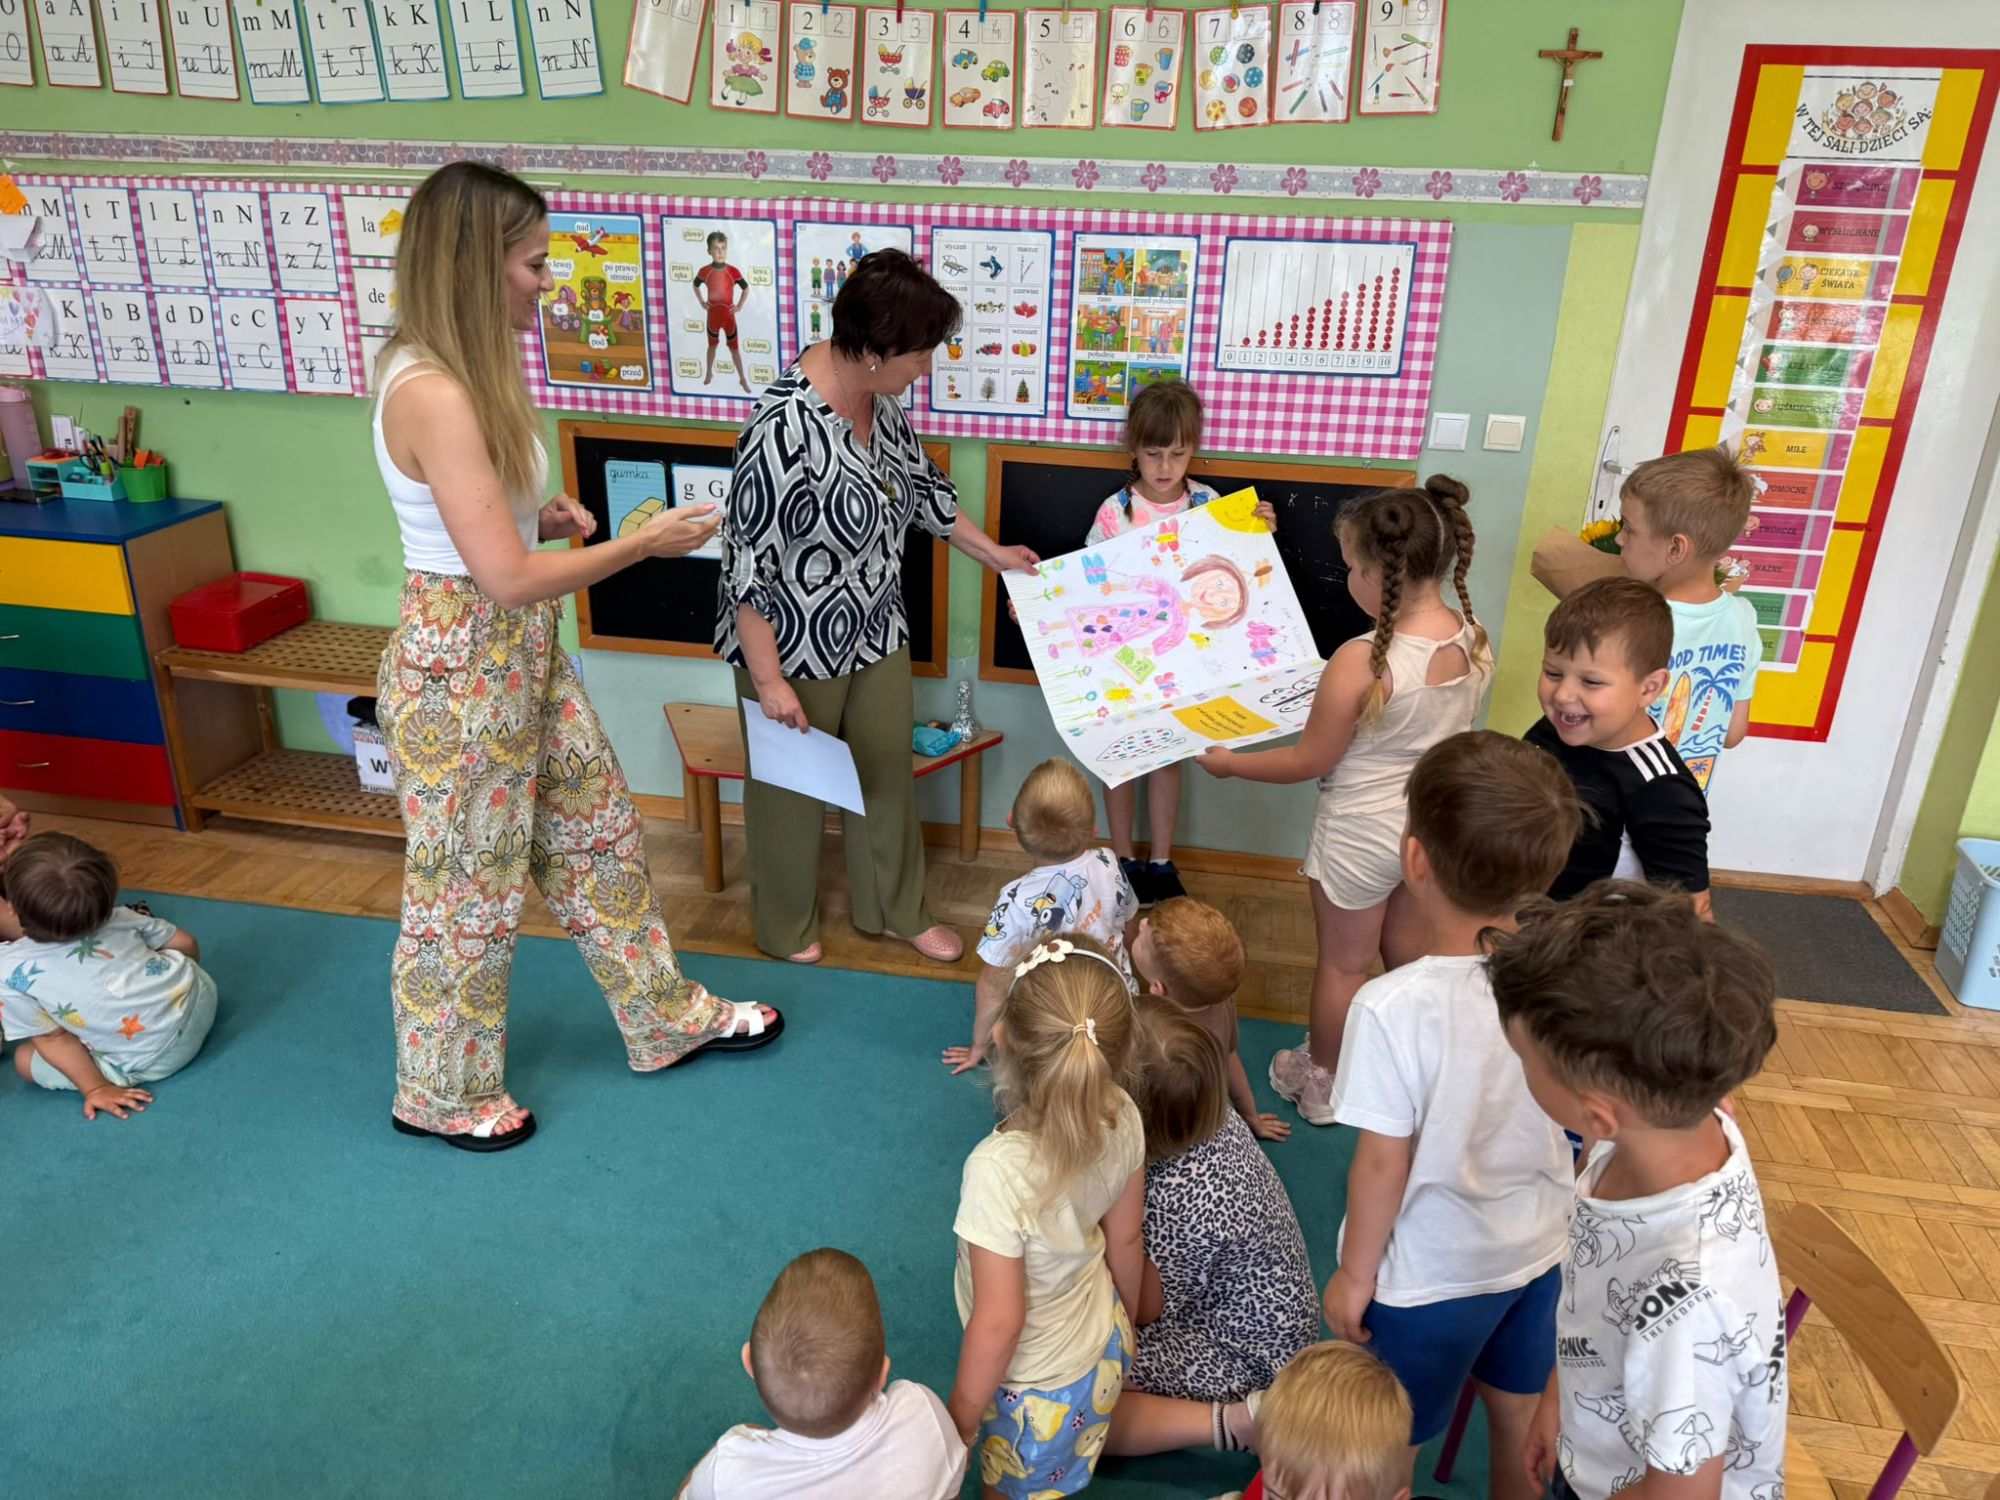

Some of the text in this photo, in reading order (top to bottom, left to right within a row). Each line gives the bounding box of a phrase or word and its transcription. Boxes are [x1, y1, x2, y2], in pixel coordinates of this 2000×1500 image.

[45, 0, 84, 16] a A
[111, 0, 149, 23] i I
[177, 6, 220, 27] u U
[383, 3, 429, 26] k K
[537, 0, 582, 22] n N
[729, 4, 735, 22] 1
[1381, 1, 1393, 22] 9
[242, 9, 293, 31] m M
[317, 7, 357, 30] t T
[803, 11, 814, 30] 2
[878, 17, 889, 36] 3
[958, 19, 970, 38] 4
[1040, 18, 1051, 39] 5
[1124, 16, 1136, 36] 6
[1209, 18, 1220, 38] 7
[1294, 10, 1306, 30] 8
[51, 34, 92, 63] a A
[182, 43, 229, 75] u U
[1796, 103, 1809, 119] W
[1802, 118, 1825, 143] TEJ
[1858, 126, 1908, 154] DZIECI
[1823, 135, 1853, 153] SALI
[84, 200, 120, 219] t T
[213, 205, 253, 224] n N
[362, 217, 375, 233] la
[576, 223, 590, 231] nad
[368, 288, 386, 304] de
[62, 300, 78, 318] K
[101, 302, 141, 321] b B
[166, 305, 203, 324] d D
[295, 312, 333, 334] y Y
[1227, 353, 1390, 366] 0 1 2 3 4 5 6 7 8 9 10
[610, 466, 650, 483] gumka
[684, 480, 724, 500] g G
[1667, 643, 1747, 671] OOD TIMES
